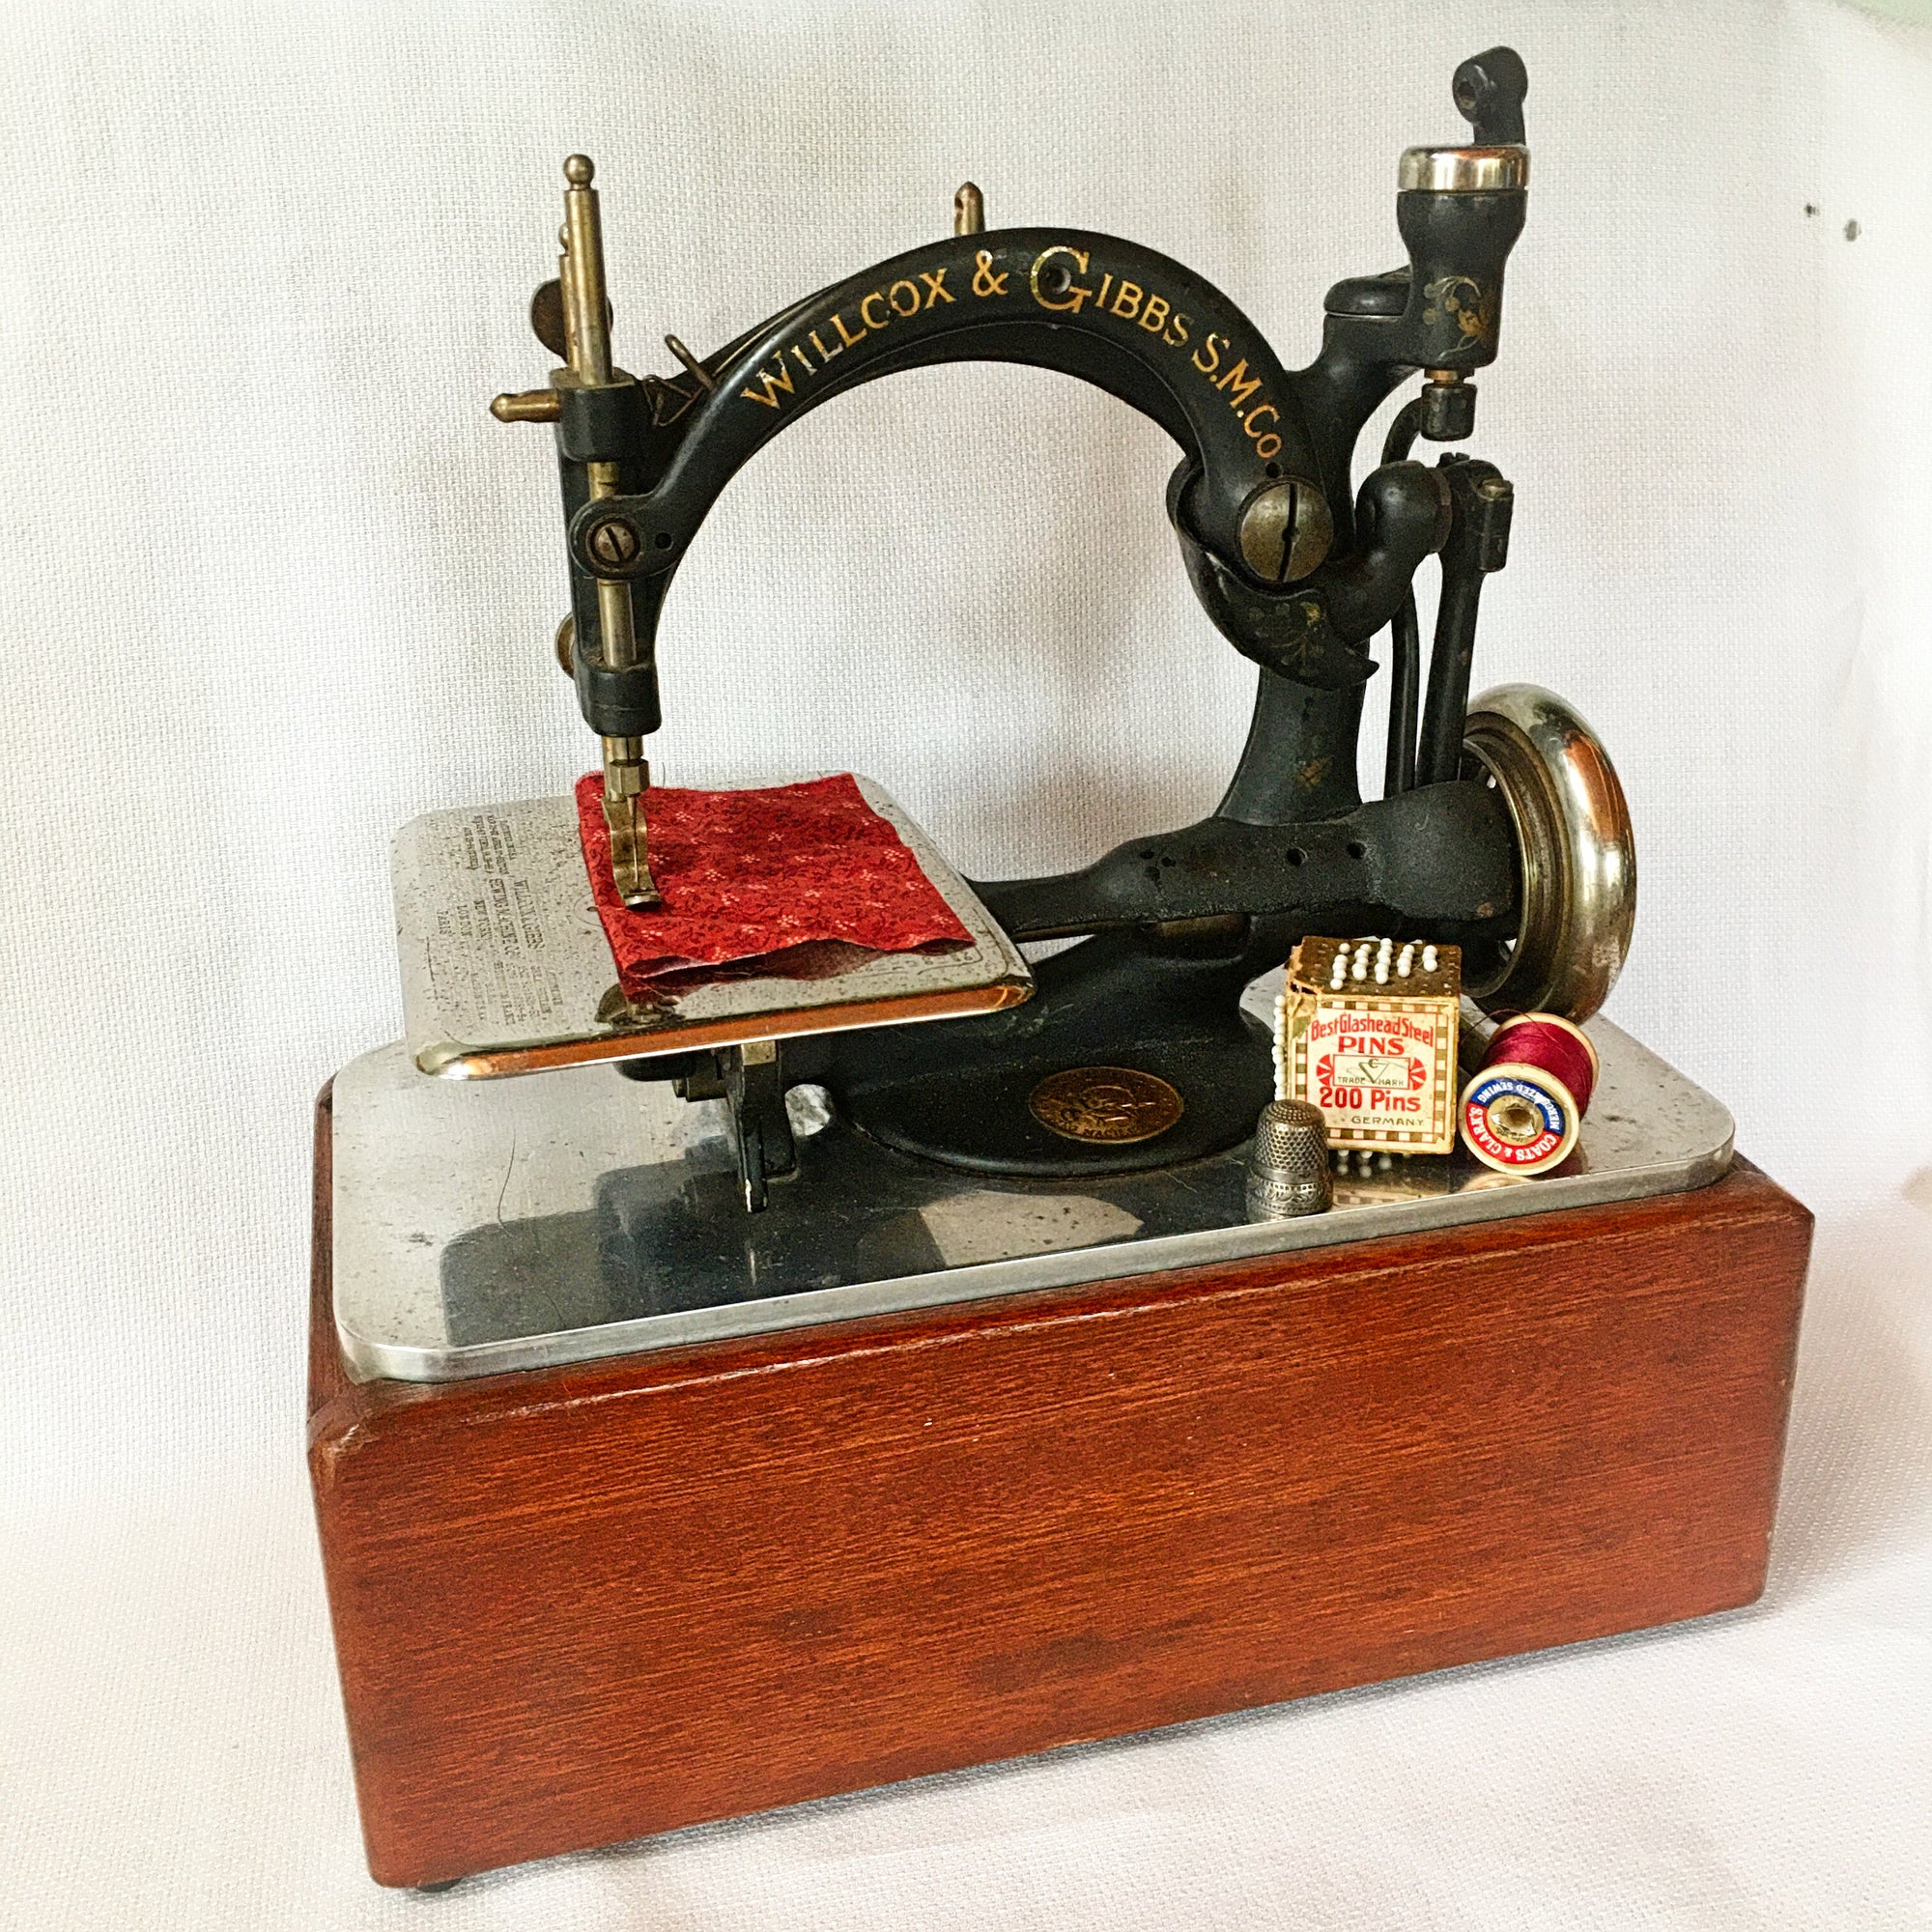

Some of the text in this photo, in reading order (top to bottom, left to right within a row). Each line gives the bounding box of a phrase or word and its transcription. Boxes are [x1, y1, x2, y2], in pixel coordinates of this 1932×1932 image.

[741, 267, 956, 410] WILLCOX
[971, 250, 1009, 298] &
[1030, 245, 1194, 348] GIBBS
[1311, 1012, 1434, 1047] Best Glashead Steel
[1338, 1036, 1405, 1056] PINS
[1337, 1076, 1365, 1085] TRADE
[1319, 1087, 1421, 1112] 200 Pins
[1477, 1082, 1514, 1103] SEWING
[1351, 1115, 1425, 1126] GERMANY
[1468, 1106, 1557, 1161] COATS & CLARK'S
